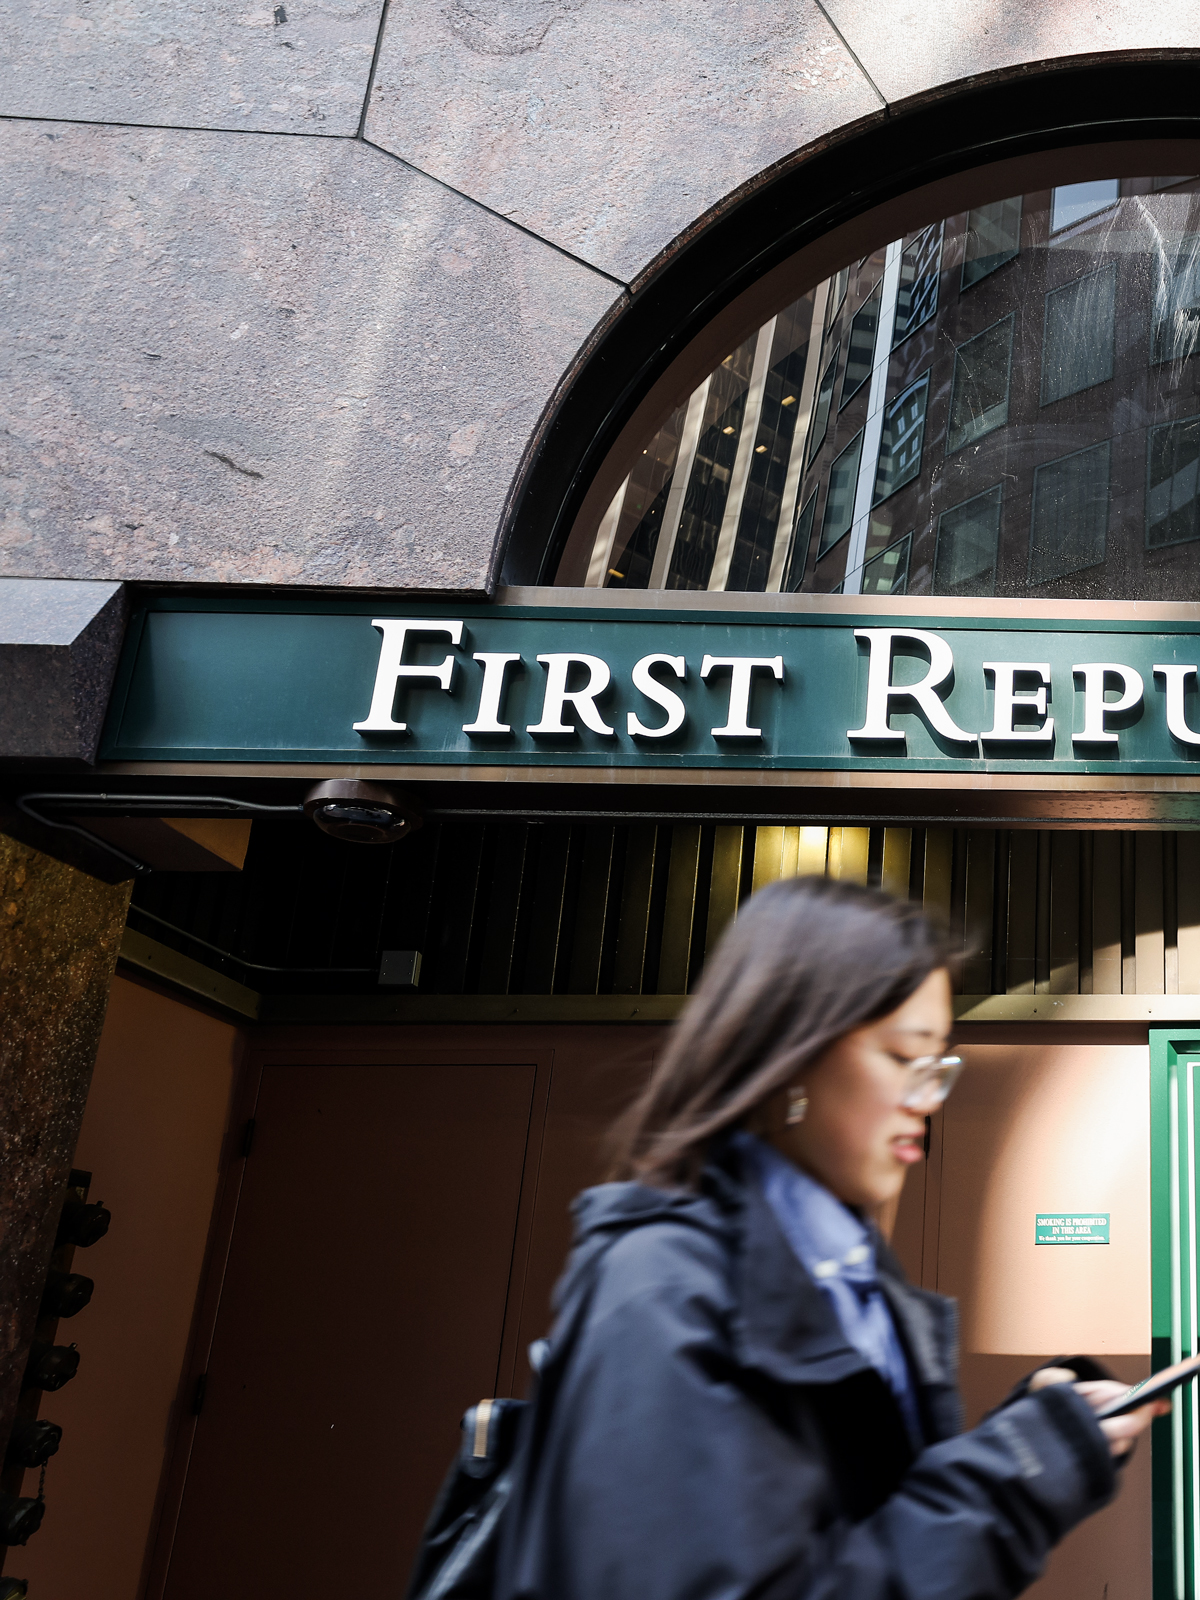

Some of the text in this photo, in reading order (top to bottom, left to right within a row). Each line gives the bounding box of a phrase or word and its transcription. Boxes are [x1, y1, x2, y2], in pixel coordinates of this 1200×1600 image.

[352, 618, 784, 739] FIRST
[1037, 1218, 1107, 1226] SMOKING IS PROHIBITED
